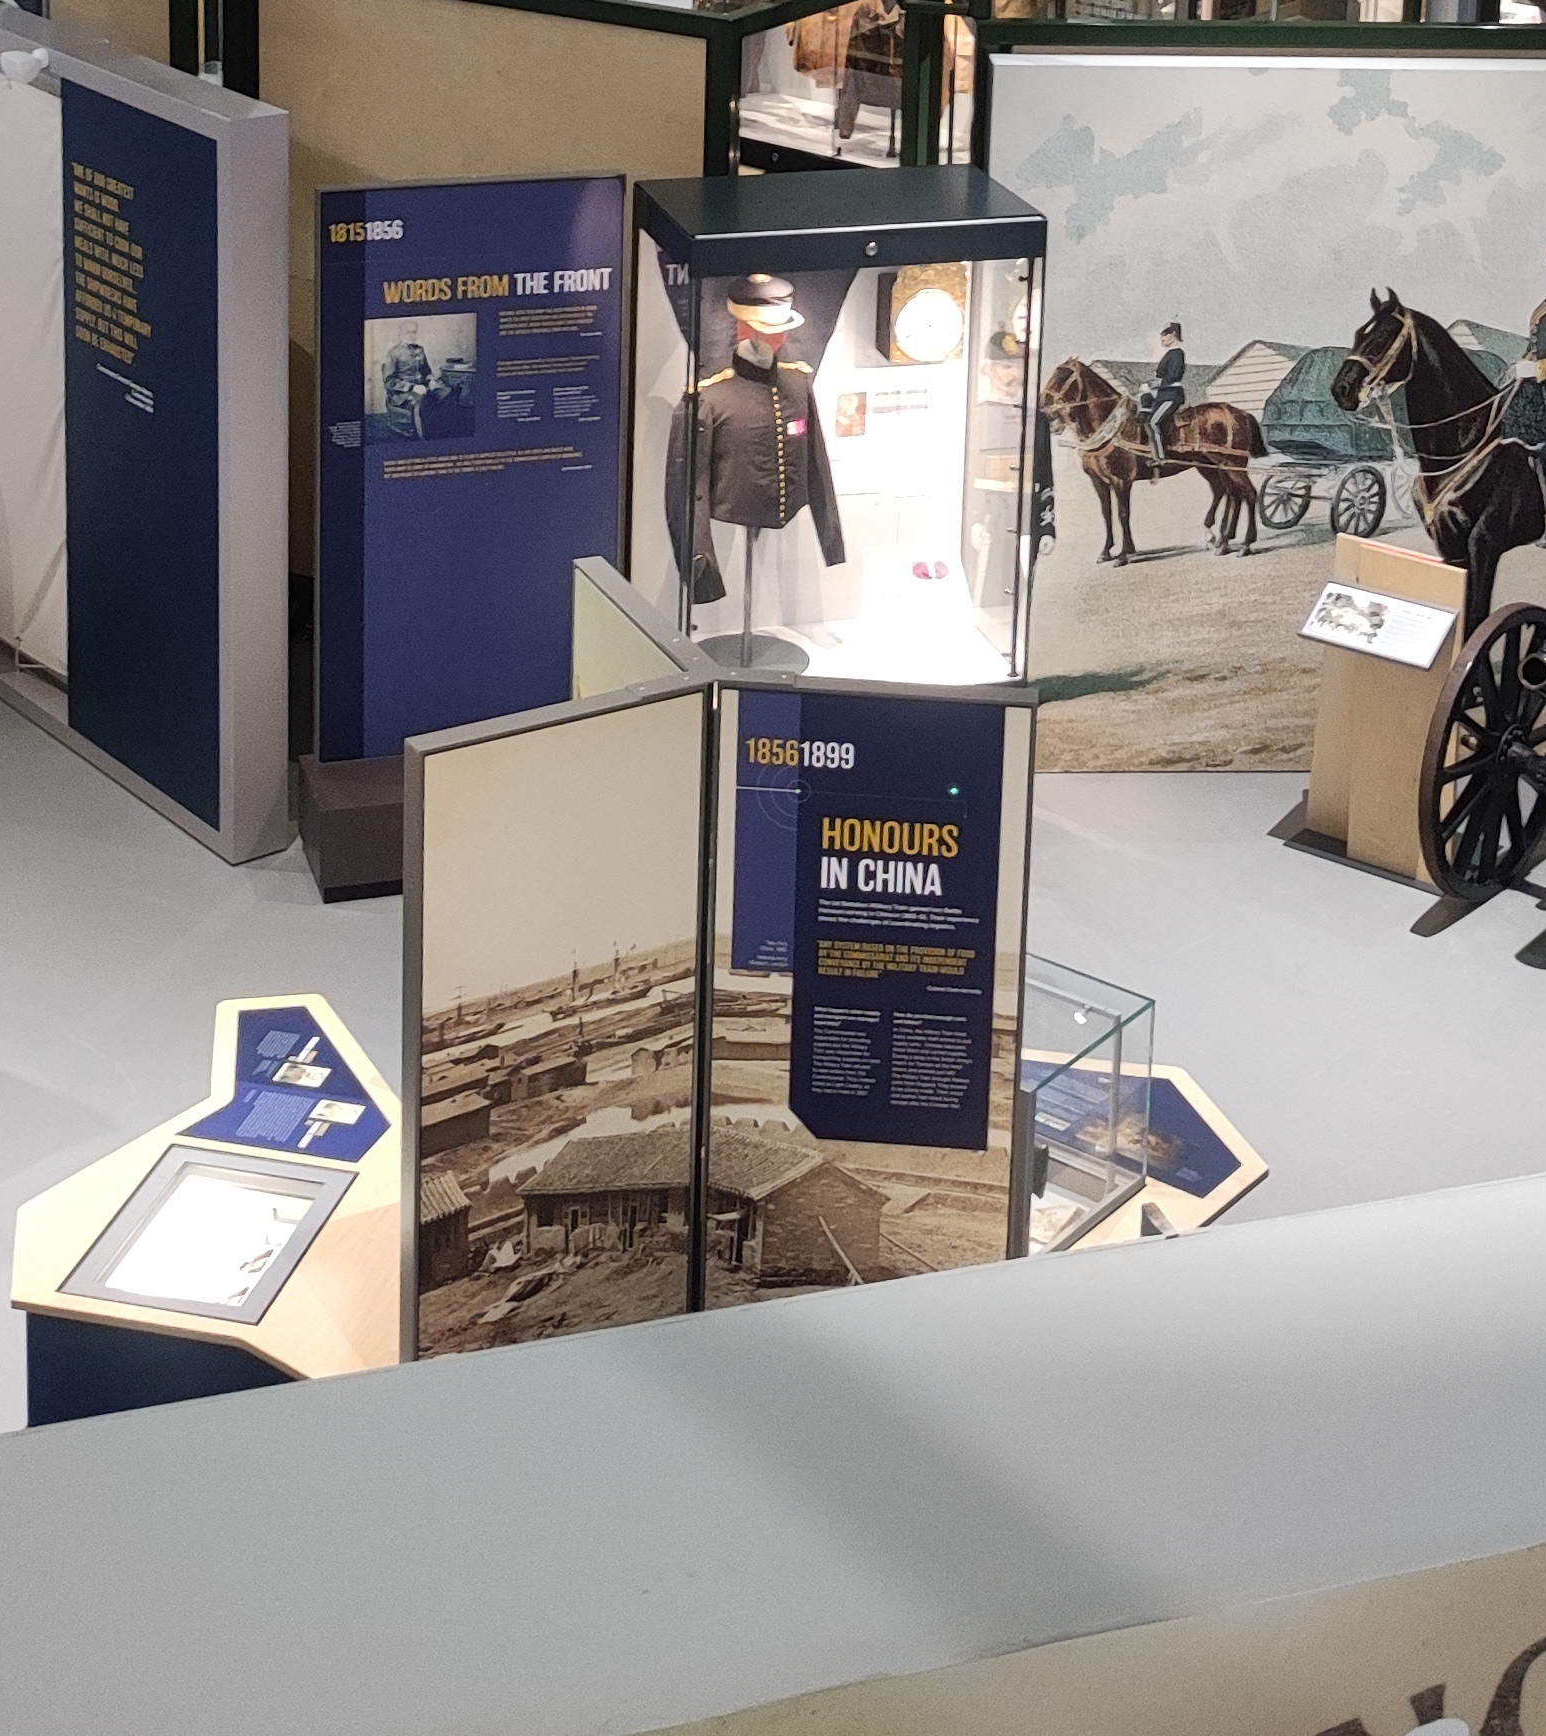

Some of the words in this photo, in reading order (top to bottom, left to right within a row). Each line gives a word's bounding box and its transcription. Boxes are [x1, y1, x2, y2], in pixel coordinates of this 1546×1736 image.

[328, 219, 404, 243] 18151856
[383, 277, 452, 304] WORDS
[457, 274, 510, 300] FROM
[514, 271, 550, 295] THE
[553, 267, 613, 294] FRONT
[744, 737, 856, 769] 18561899
[821, 816, 959, 858] HONOURS
[820, 856, 849, 890] IN
[857, 857, 943, 896] CHINA
